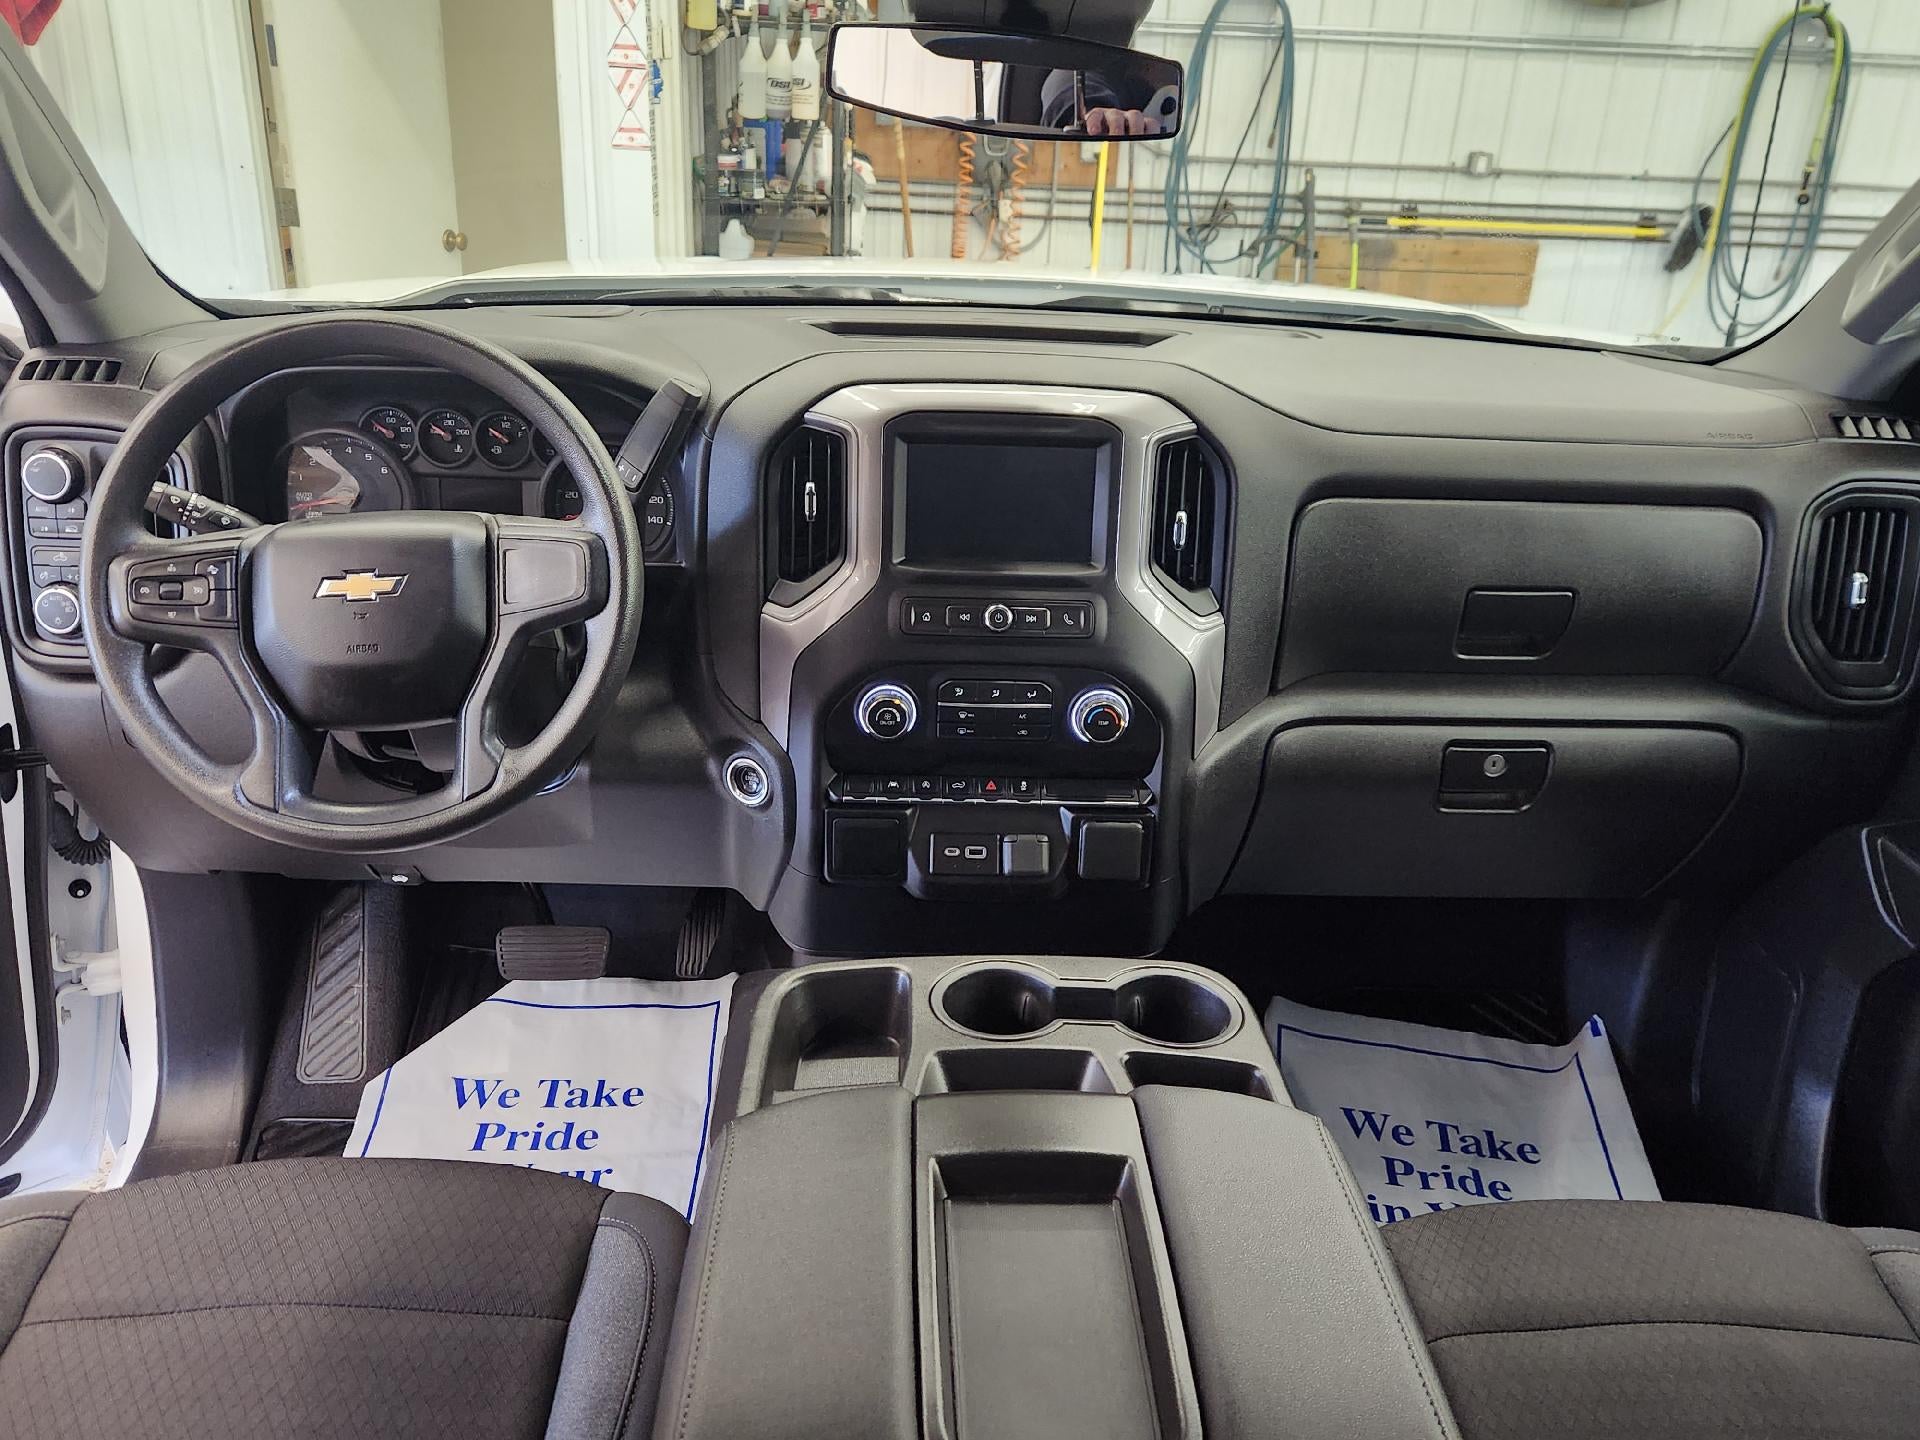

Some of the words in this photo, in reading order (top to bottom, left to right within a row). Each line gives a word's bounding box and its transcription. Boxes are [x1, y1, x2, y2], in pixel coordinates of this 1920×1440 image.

[1705, 432, 1753, 440] AIRBAG
[564, 491, 579, 499] 20
[649, 496, 664, 504] 120
[648, 516, 664, 524] 140
[346, 643, 379, 654] AIRBAG
[451, 1077, 520, 1109] We
[538, 1078, 645, 1109] Take
[467, 1121, 599, 1152] Pride
[1340, 1107, 1415, 1146] We
[1426, 1120, 1542, 1165] Take
[1381, 1156, 1513, 1201] Pride
[1367, 1194, 1412, 1224] in
